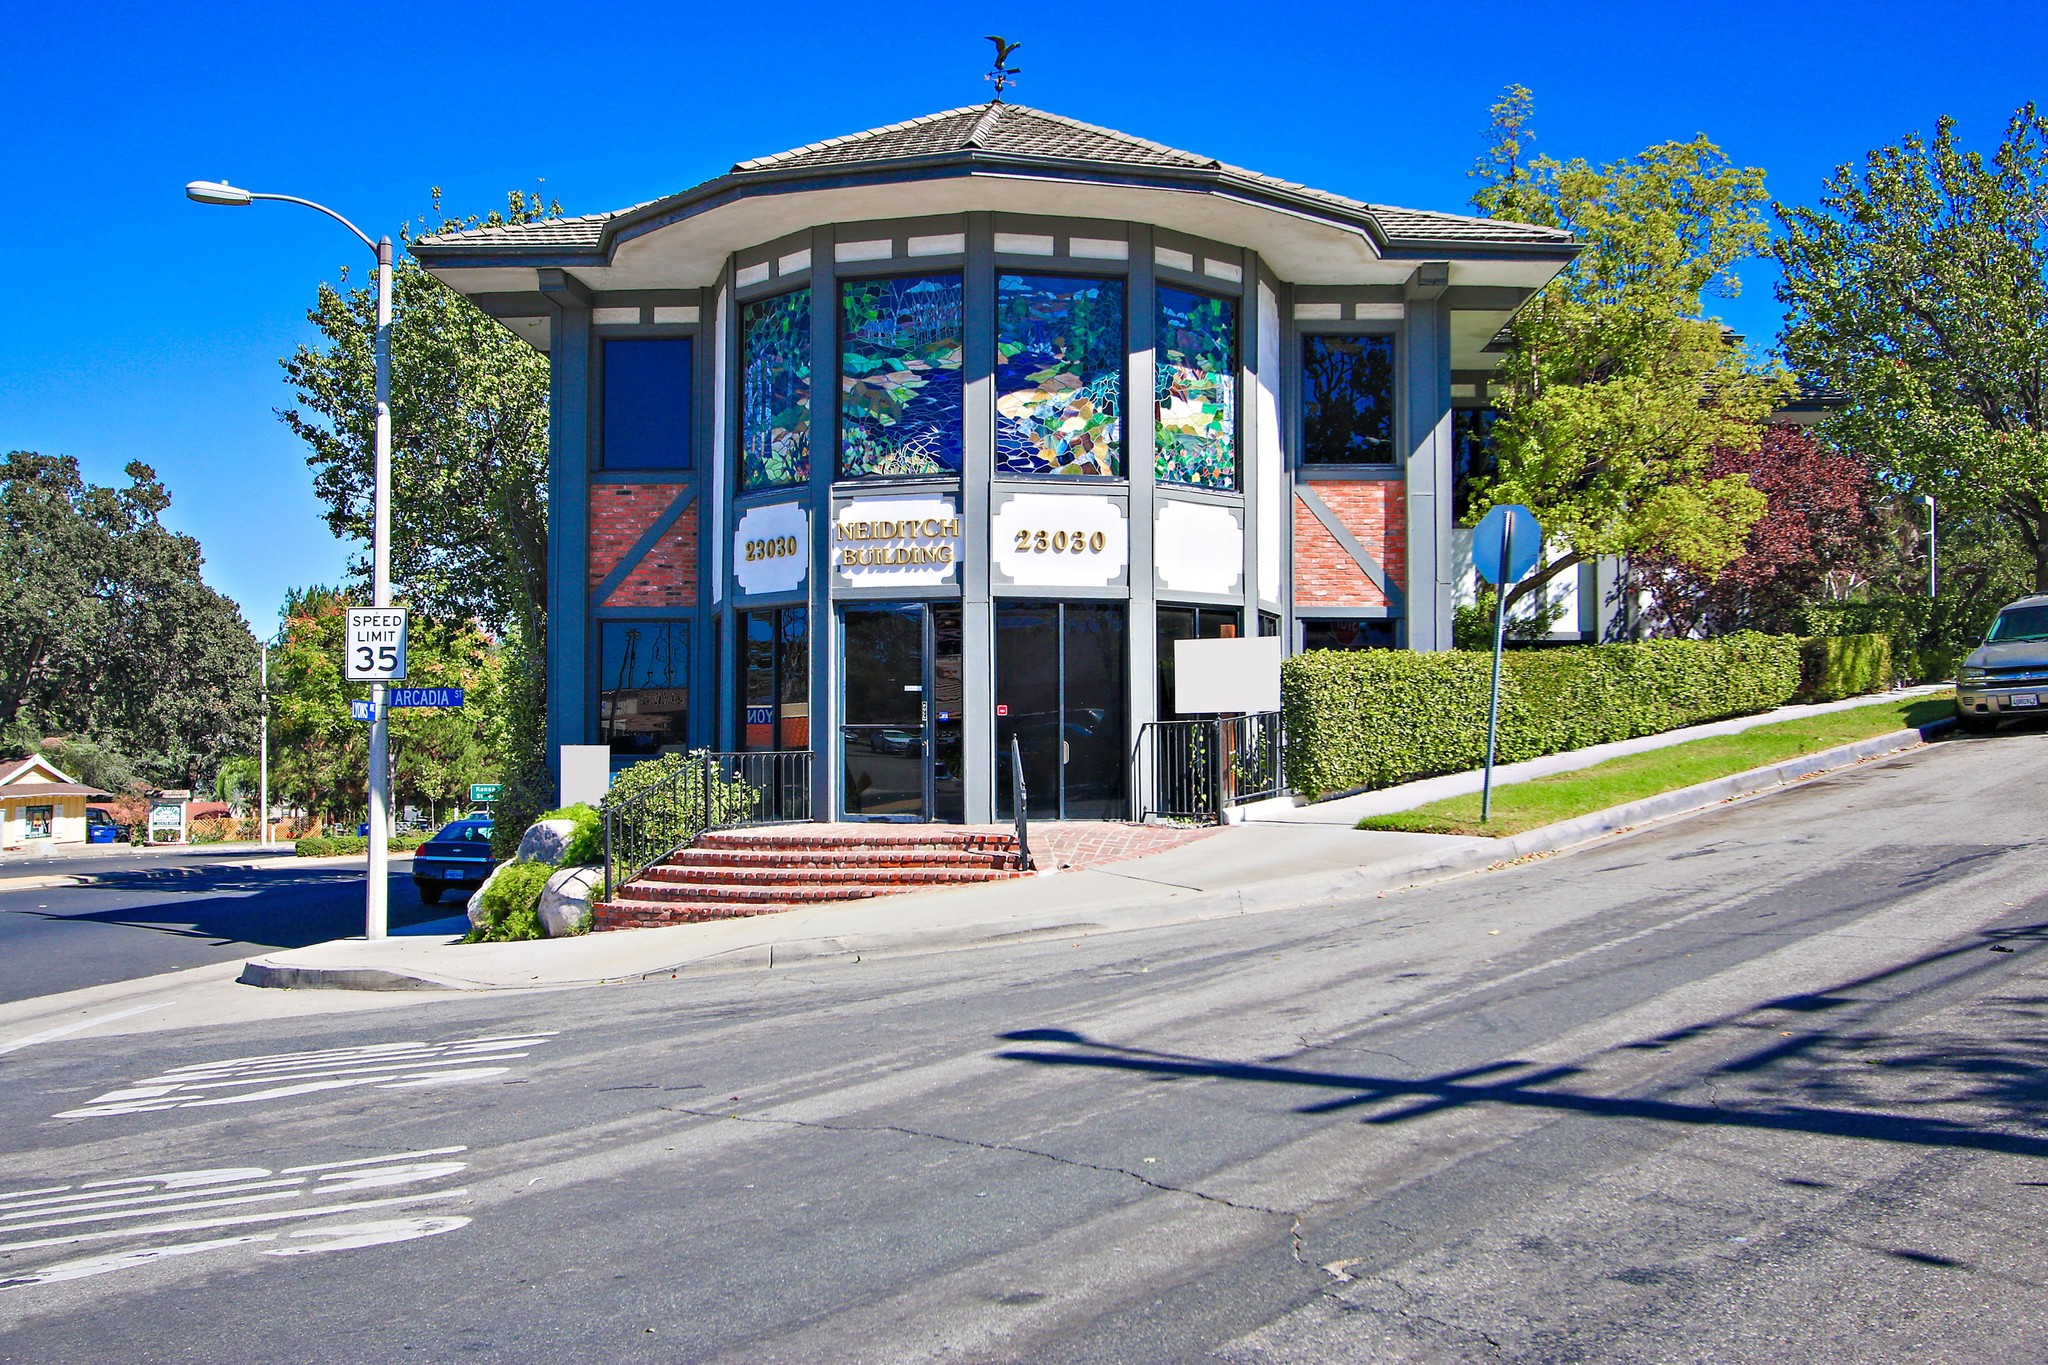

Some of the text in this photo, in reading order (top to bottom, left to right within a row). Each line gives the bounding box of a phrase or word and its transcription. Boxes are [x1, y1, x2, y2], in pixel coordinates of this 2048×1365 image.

[836, 517, 960, 542] NEIDITCH
[745, 535, 798, 561] 23030
[1014, 529, 1107, 555] 23030
[841, 545, 953, 568] BUILDING
[352, 615, 402, 627] SPEED
[357, 631, 396, 642] LIMIT
[355, 646, 398, 672] 35
[394, 690, 463, 706] ARCADIA ST
[352, 702, 369, 719] LYONS
[52, 1031, 561, 1119] STOP
